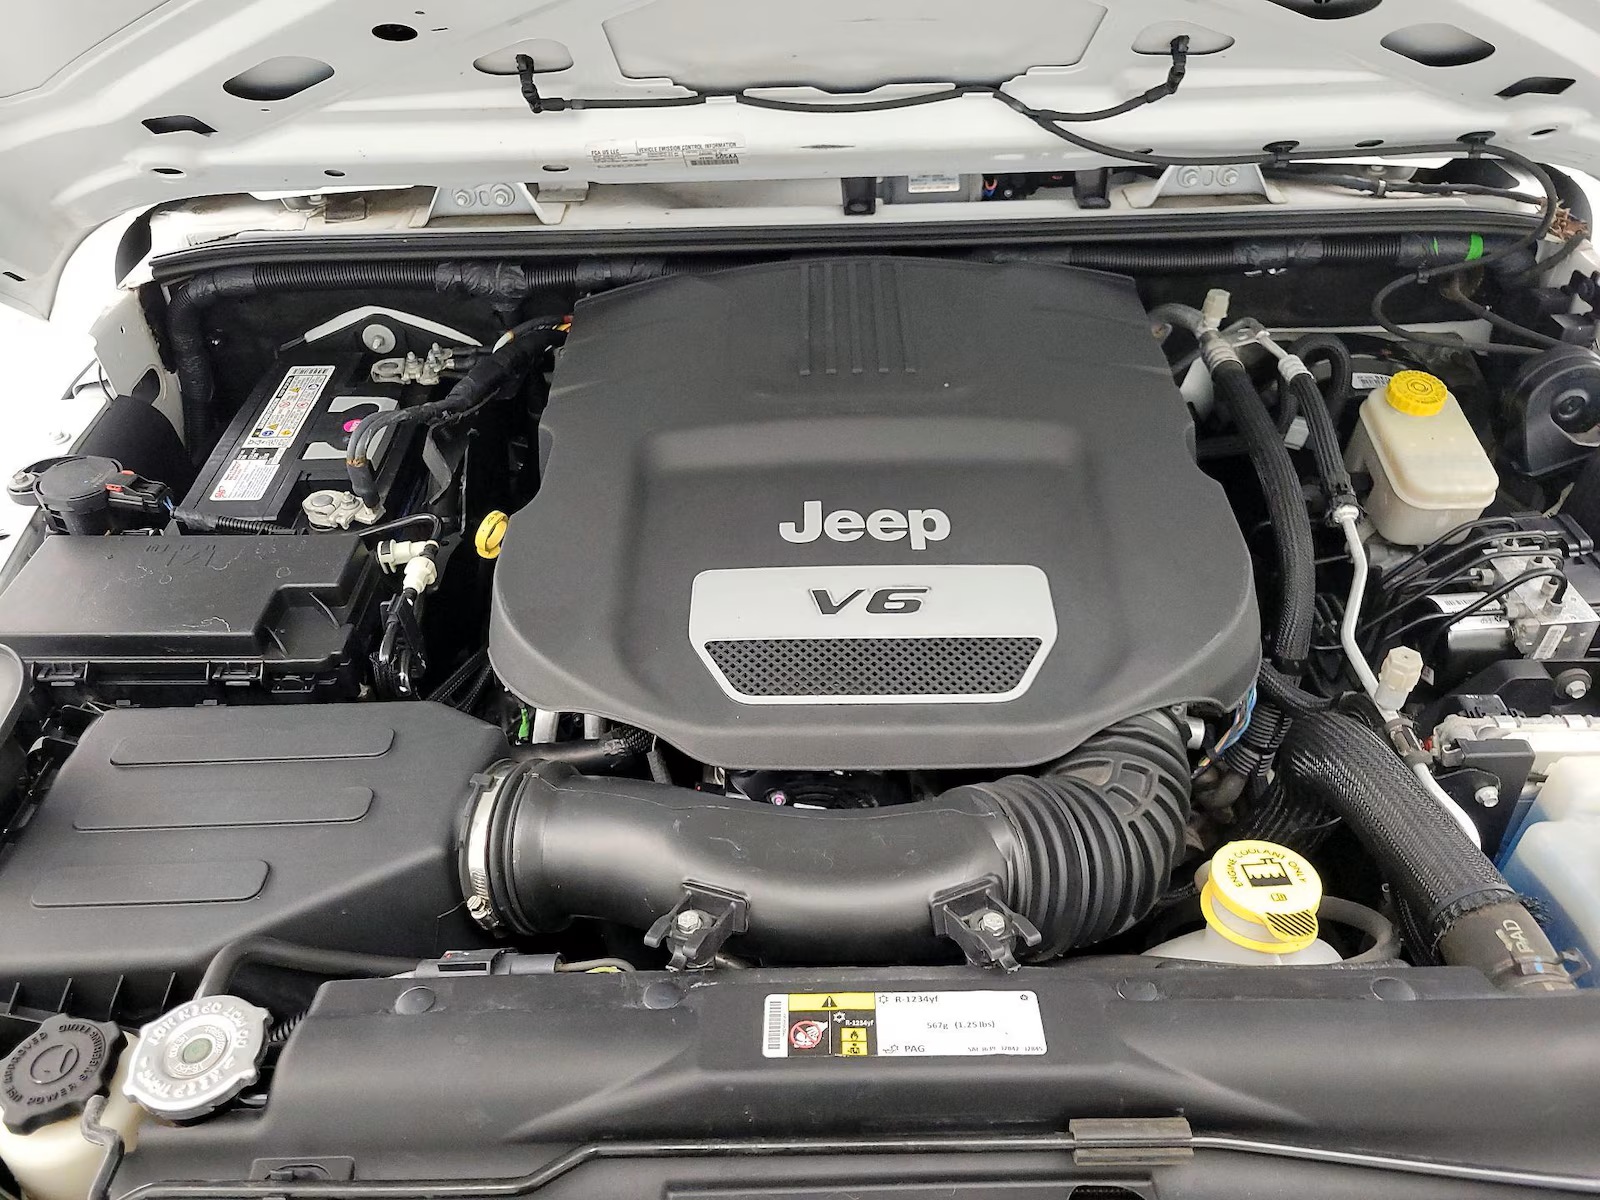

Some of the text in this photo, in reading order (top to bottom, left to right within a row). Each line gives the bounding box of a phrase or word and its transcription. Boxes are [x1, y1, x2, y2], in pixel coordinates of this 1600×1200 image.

[779, 501, 950, 550] Jeep
[811, 587, 929, 615] V6
[1227, 848, 1307, 888] ENGINE COOLANT ONLY
[895, 994, 939, 1004] R-1234yf
[845, 1019, 874, 1027] R-1234yf
[926, 1020, 996, 1030] 567g (1.25 lbs)
[904, 1045, 925, 1053] PAG
[4, 1031, 48, 1103] USE APPROVED
[27, 1083, 77, 1105] POWER
